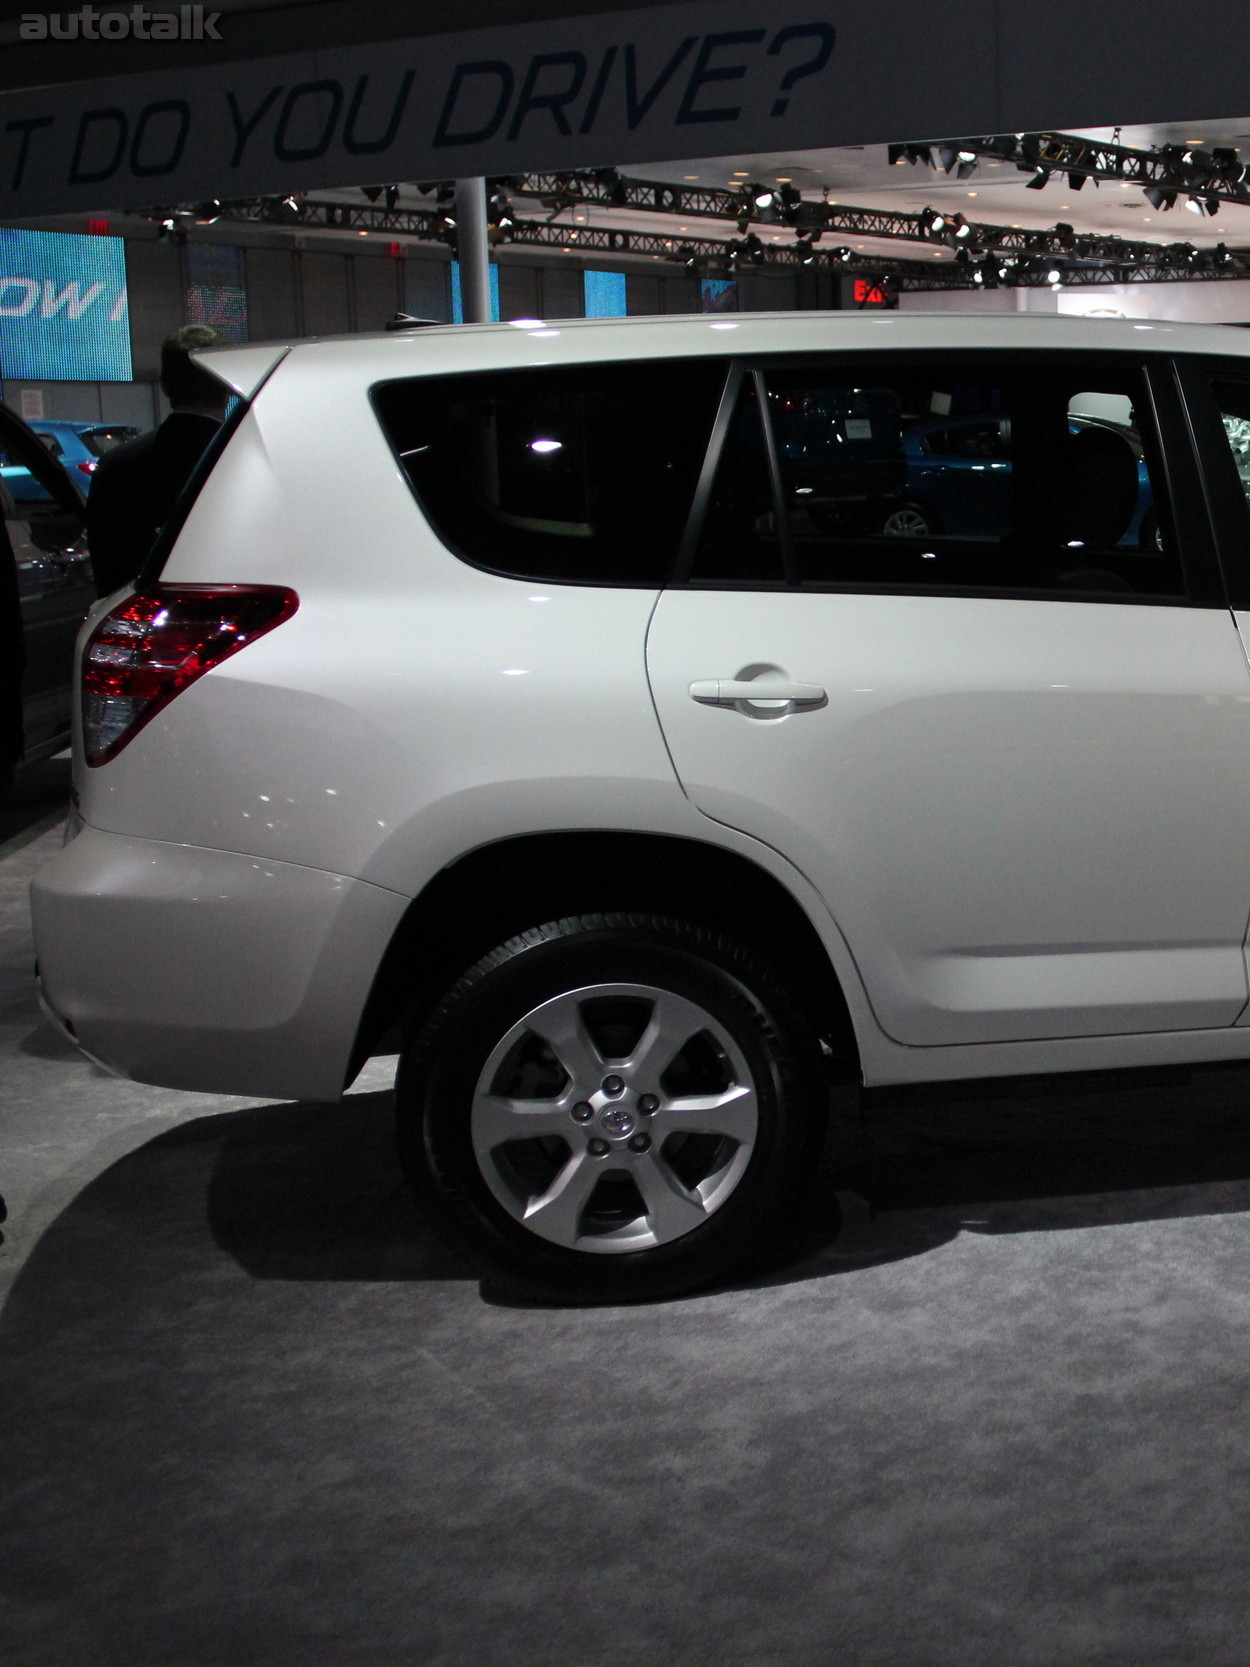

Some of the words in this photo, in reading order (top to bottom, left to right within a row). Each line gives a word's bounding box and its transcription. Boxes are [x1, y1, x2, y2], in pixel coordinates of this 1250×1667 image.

[67, 100, 191, 185] DO
[226, 69, 417, 168] YOU
[432, 21, 837, 148] DRIVE?
